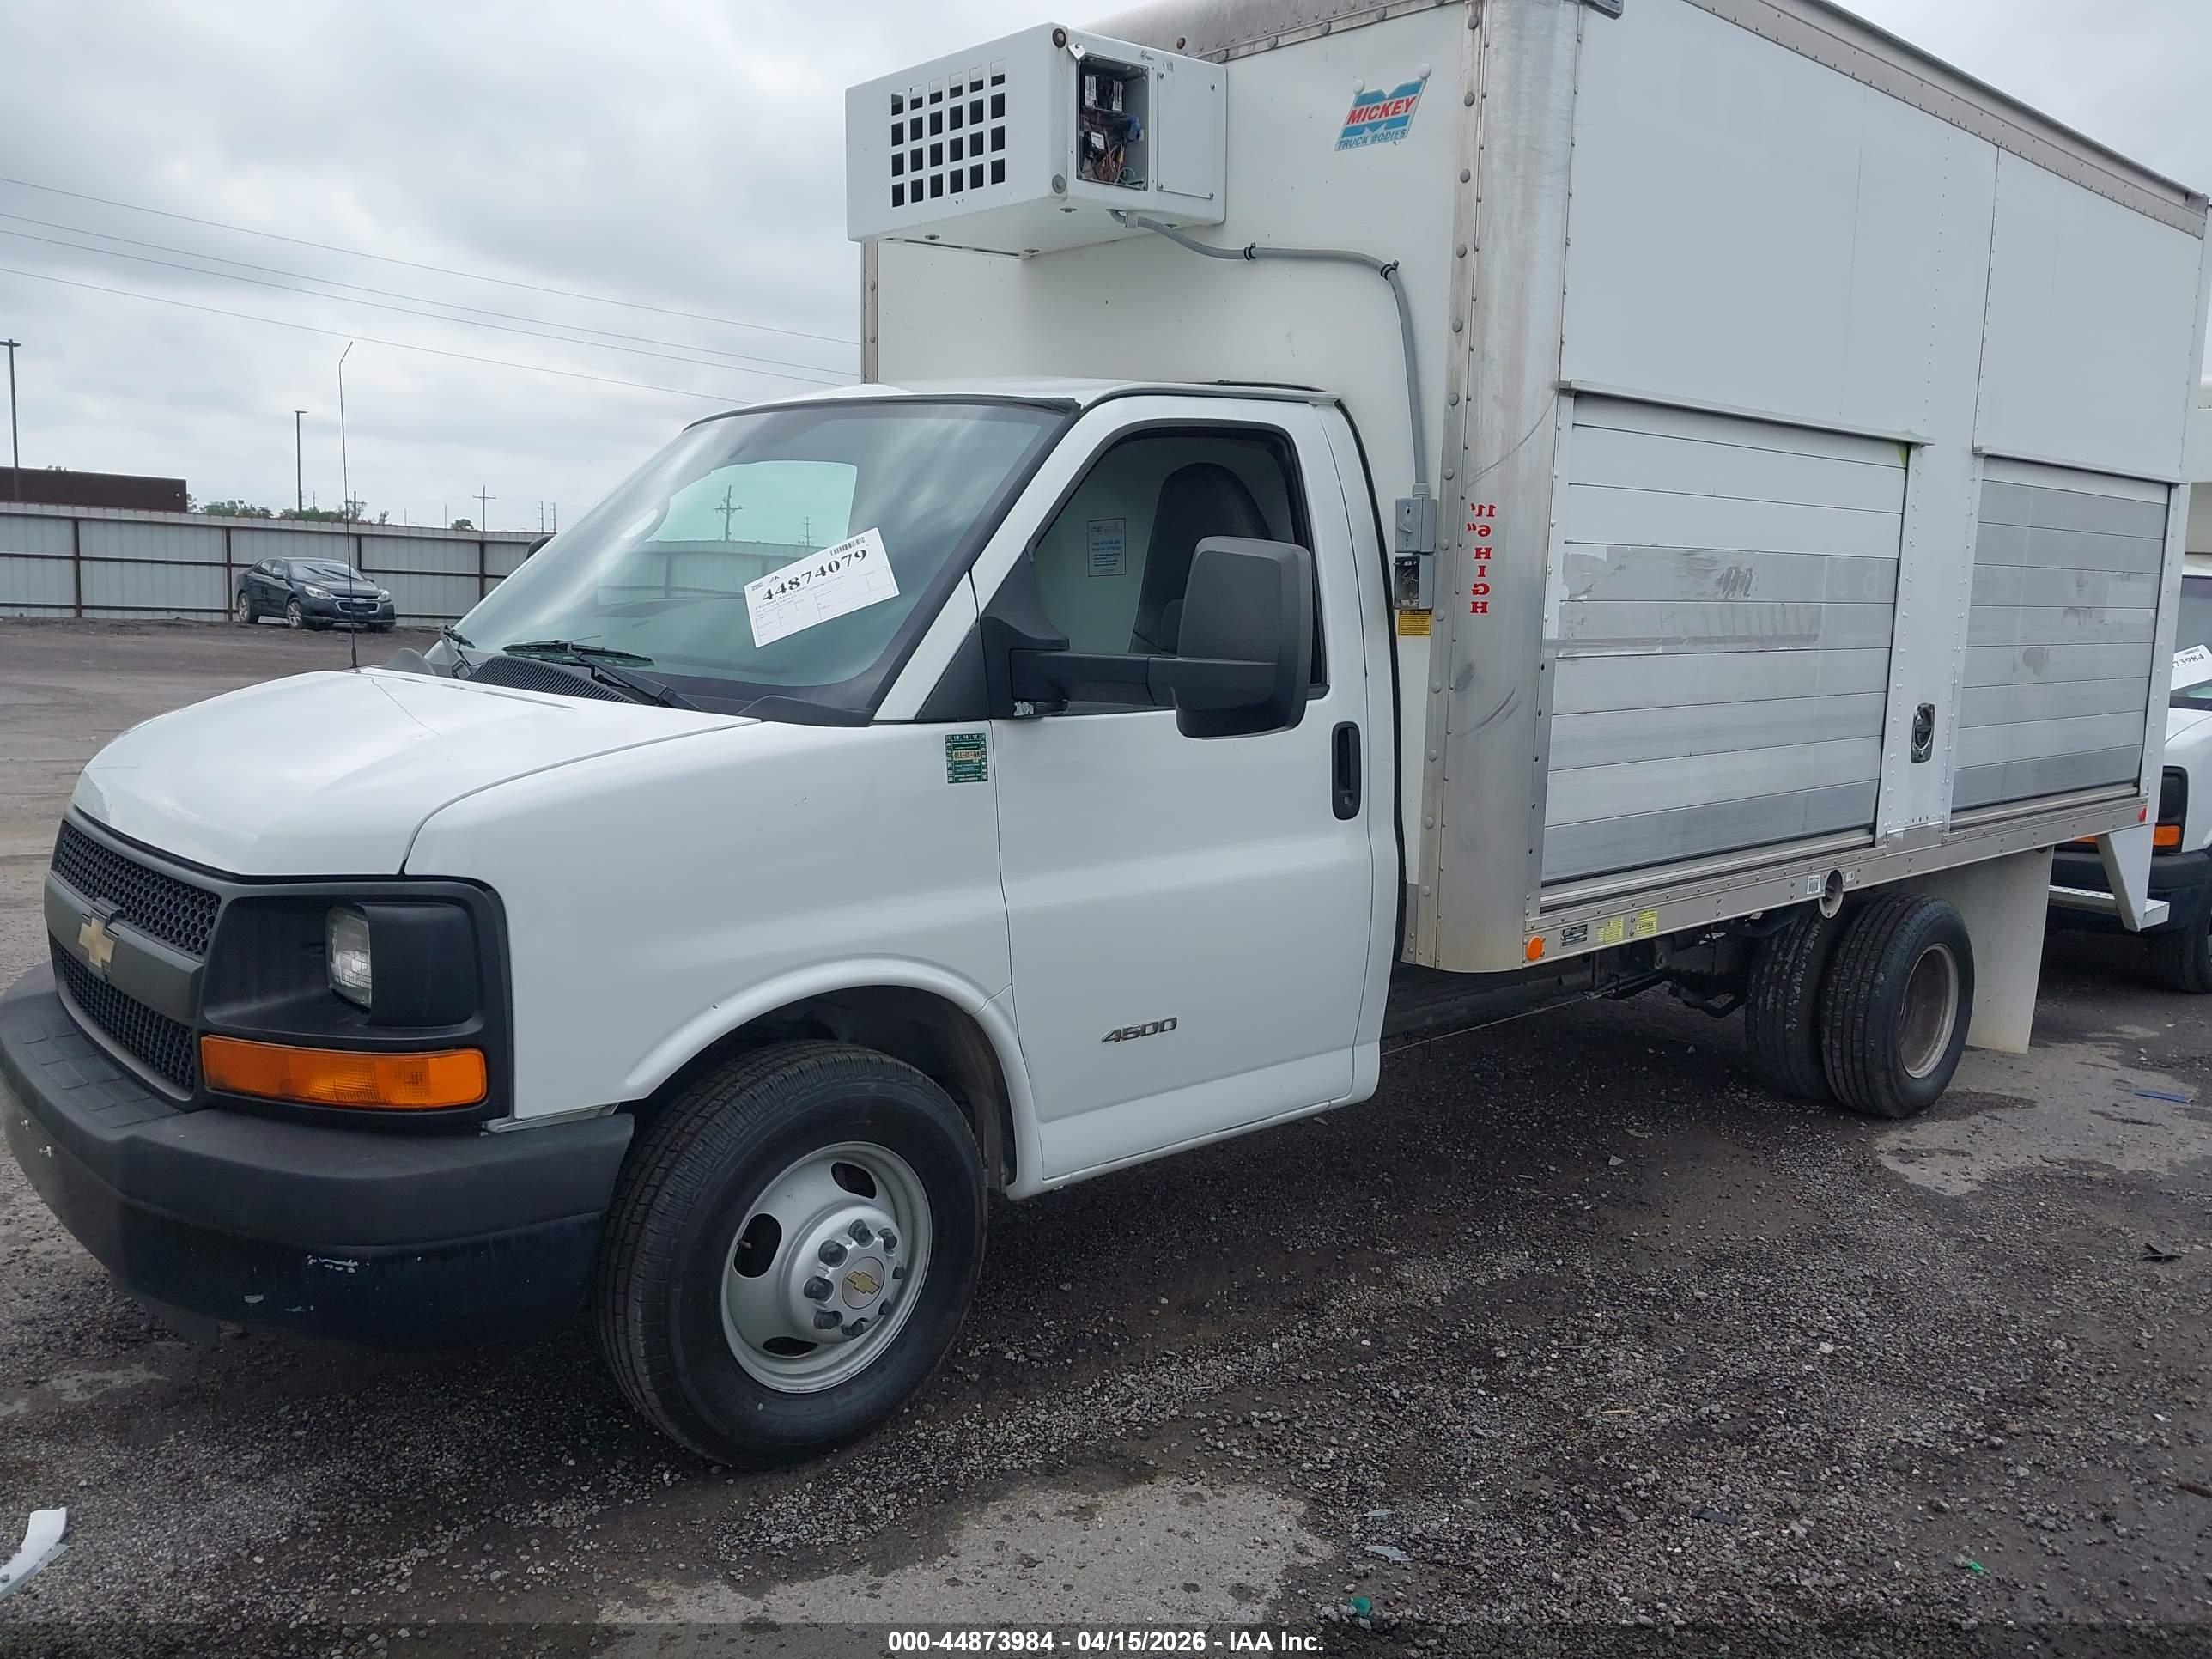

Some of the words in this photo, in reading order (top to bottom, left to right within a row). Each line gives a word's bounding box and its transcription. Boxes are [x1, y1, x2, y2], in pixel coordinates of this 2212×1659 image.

[1346, 95, 1417, 125] MICKEY
[1337, 136, 1369, 150] TRUCK
[1371, 129, 1407, 143] BODIES
[762, 549, 867, 601] 44874079
[2172, 653, 2204, 668] 73984
[1101, 1017, 1177, 1042] 4500
